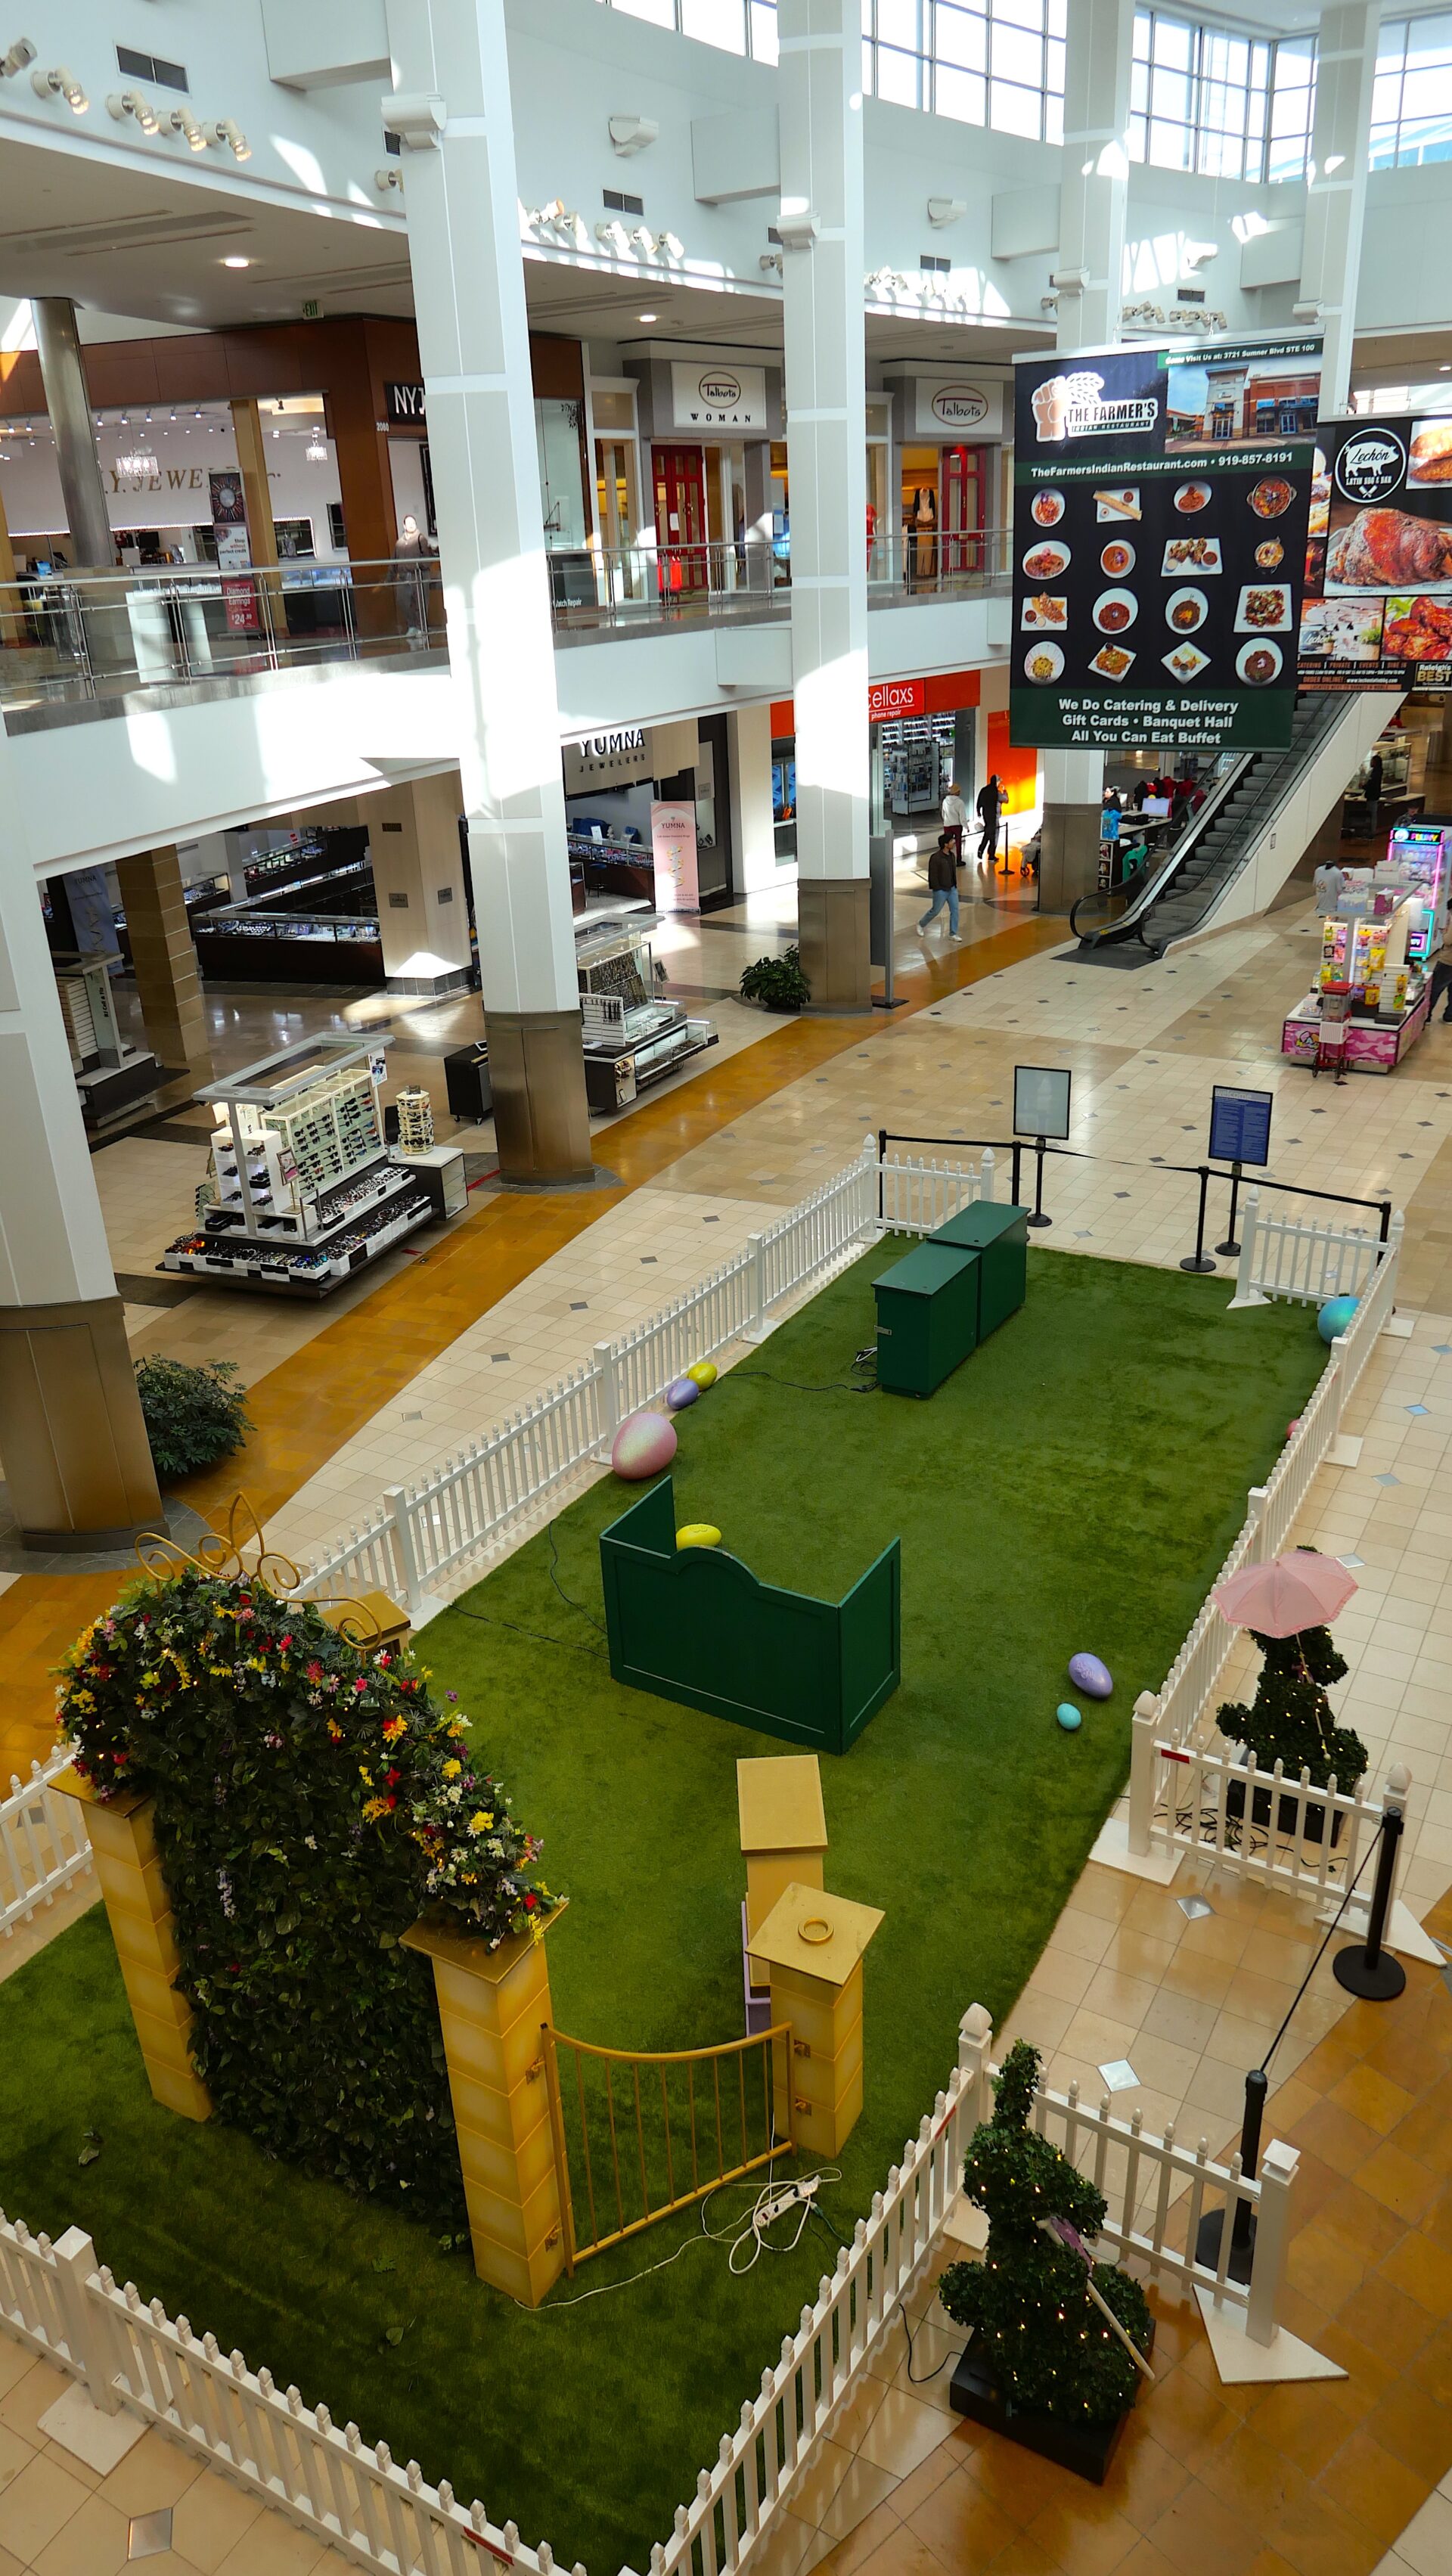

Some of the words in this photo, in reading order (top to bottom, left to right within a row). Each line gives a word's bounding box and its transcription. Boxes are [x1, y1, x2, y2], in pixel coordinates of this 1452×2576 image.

[306, 302, 318, 317] EXIT
[703, 383, 737, 398] Talbots
[937, 397, 983, 417] Talbots
[1068, 408, 1089, 423] THE
[1094, 402, 1155, 421] FARMER'S
[1101, 420, 1150, 430] RESTAURANT
[1350, 448, 1390, 464] Lechón
[1031, 459, 1208, 478] TheFarmersIndianRestaurant.com
[1218, 452, 1293, 467] 919-857-8191
[1346, 476, 1363, 486] LATIN
[1380, 475, 1392, 484] BAR
[227, 586, 250, 595] Diamond
[228, 597, 250, 607] Earrings
[567, 597, 582, 608] Repair
[1416, 671, 1452, 682] BEST
[1059, 699, 1079, 710] We
[1082, 699, 1100, 710] Do
[1103, 699, 1161, 713] Catering
[1165, 700, 1177, 712] &
[1180, 700, 1239, 714] Delivery
[871, 712, 886, 721] phone
[887, 709, 901, 718] repair
[1063, 714, 1087, 726] Gift
[1090, 715, 1129, 726] Cards
[1143, 715, 1201, 729] Banquet
[1205, 715, 1233, 728] Hall
[579, 728, 646, 758] YUMNA
[1072, 731, 1089, 742] All
[1093, 731, 1118, 742] You
[1121, 731, 1147, 743] Can
[1151, 731, 1174, 743] Eat
[1178, 731, 1221, 744] Buffet
[579, 754, 646, 773] JEWELERS
[1215, 1089, 1252, 1099] welcome
